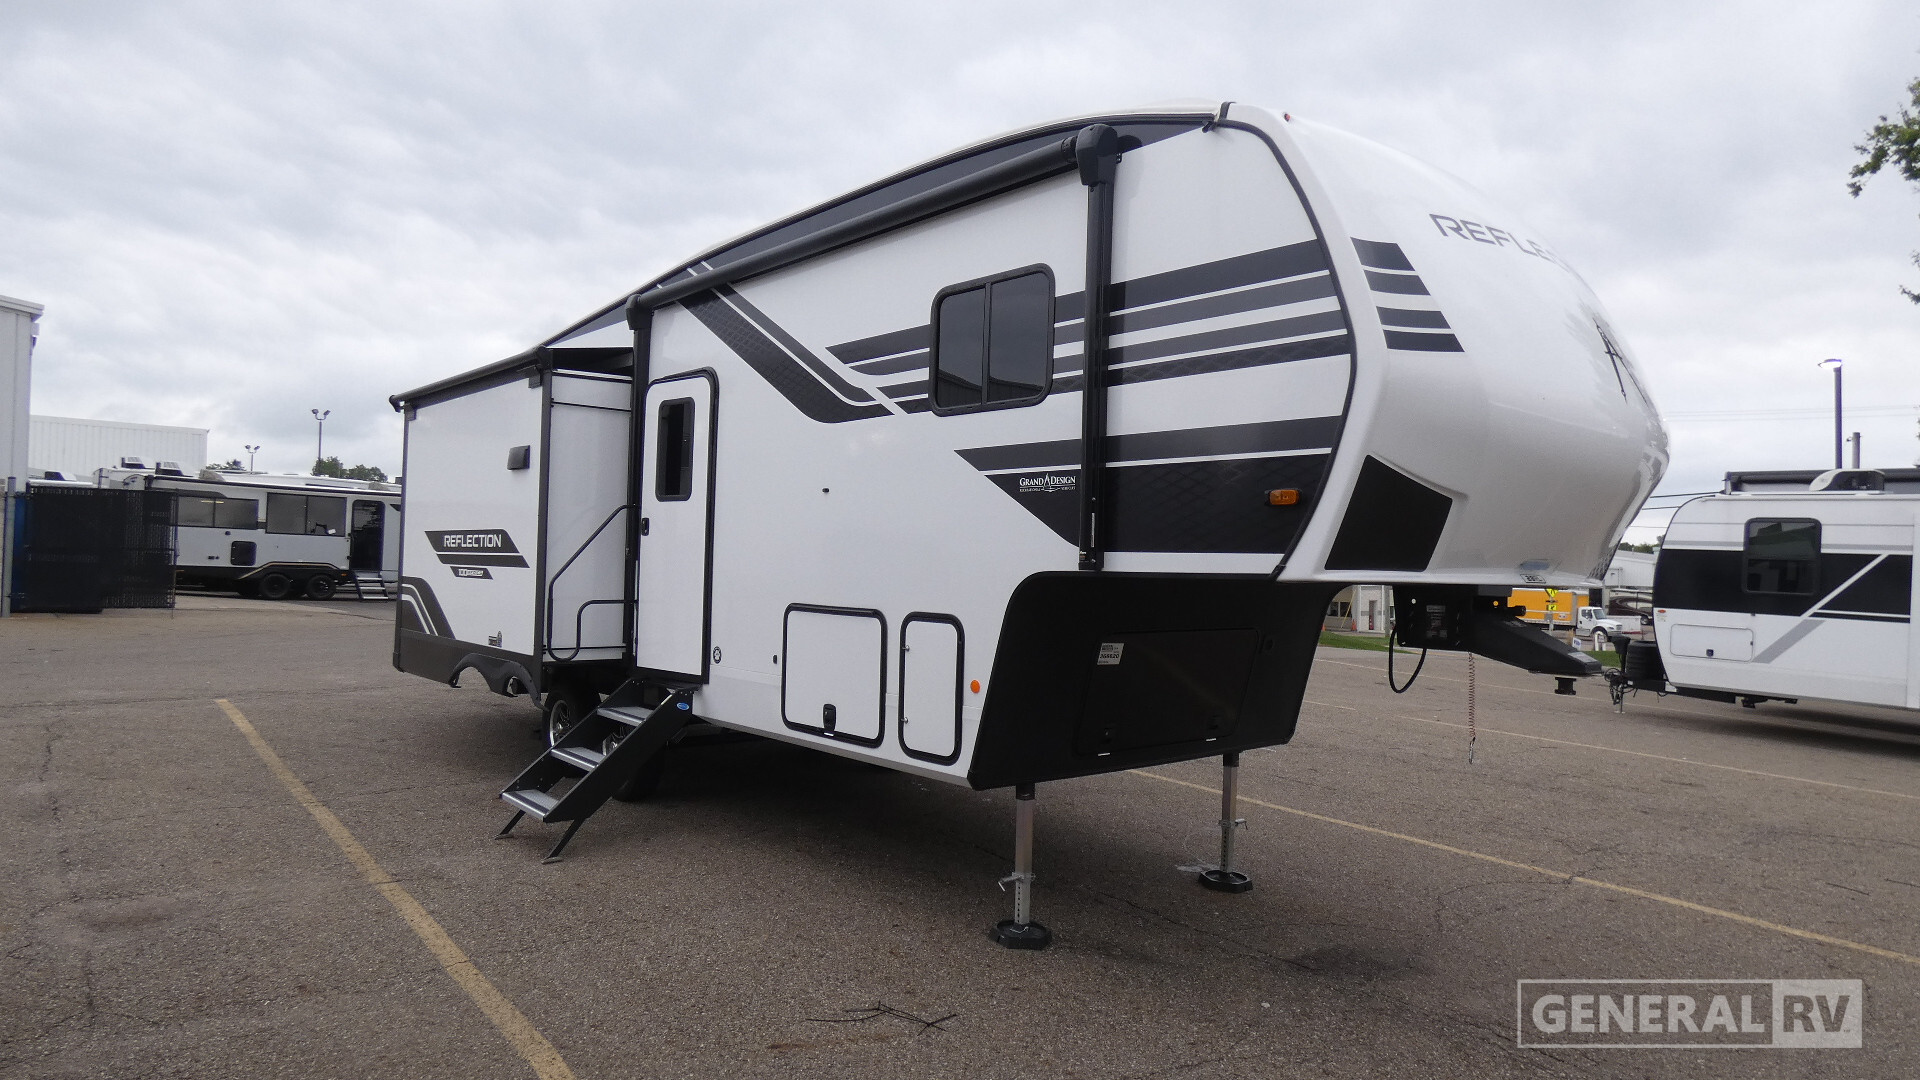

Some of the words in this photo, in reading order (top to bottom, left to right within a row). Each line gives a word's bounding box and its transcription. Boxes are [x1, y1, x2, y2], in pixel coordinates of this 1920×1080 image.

[1020, 477, 1044, 486] GRAND
[1051, 475, 1076, 485] DESIGN
[444, 534, 502, 548] REFLECTION
